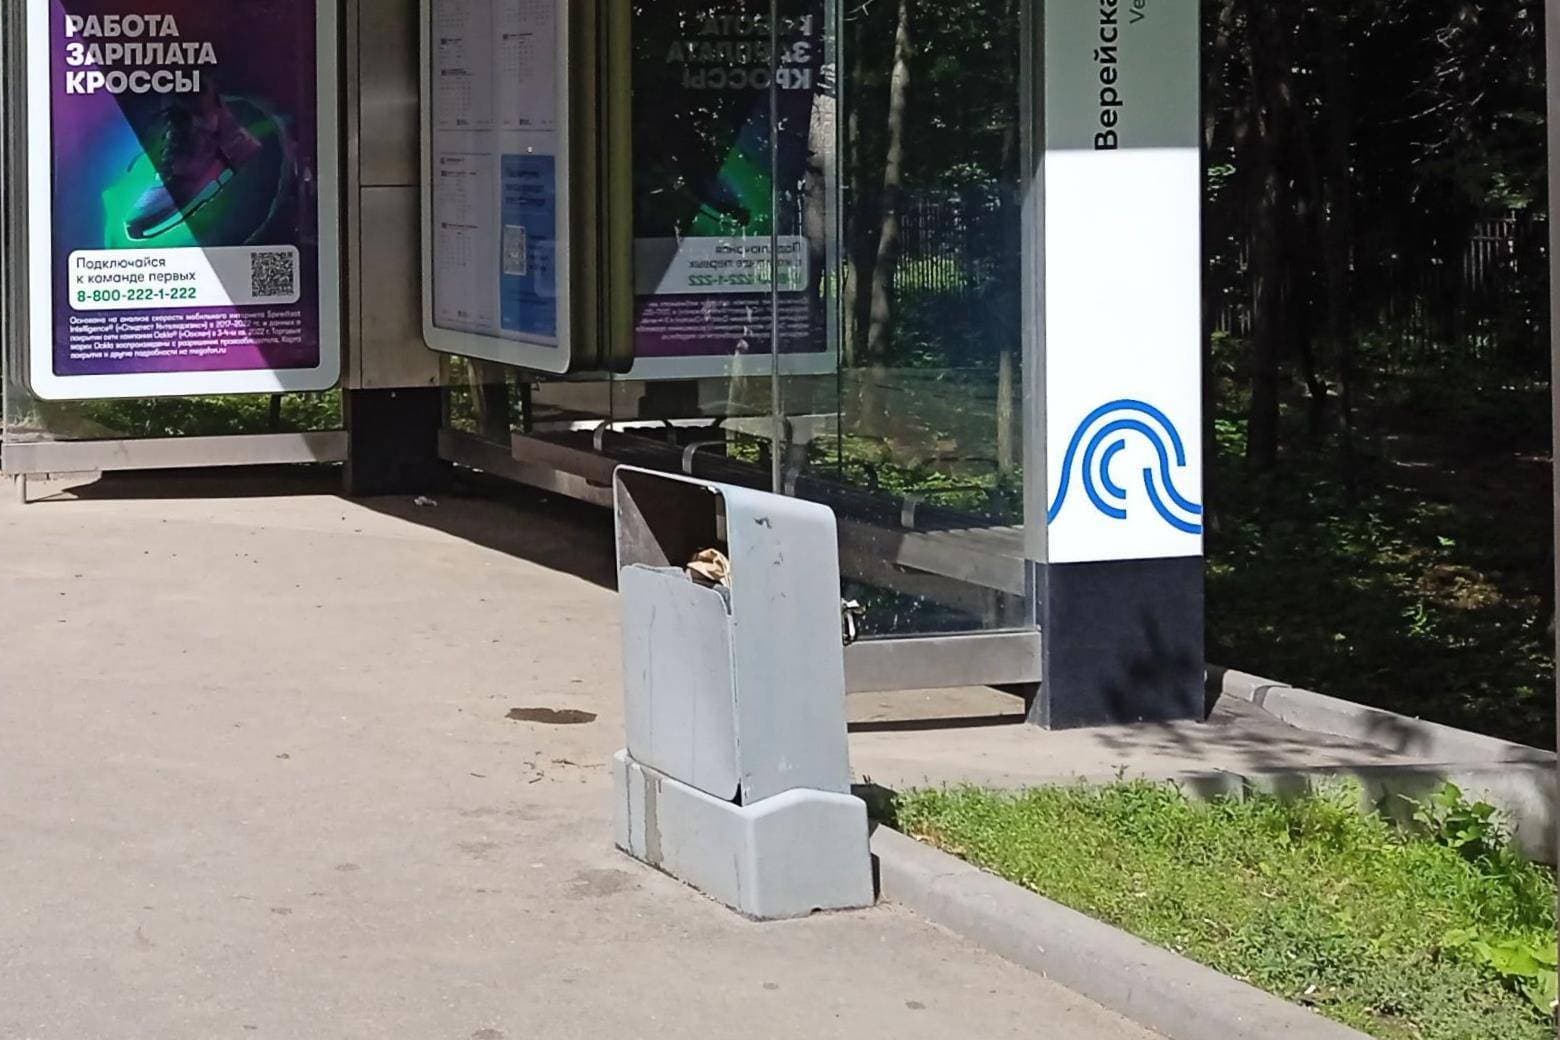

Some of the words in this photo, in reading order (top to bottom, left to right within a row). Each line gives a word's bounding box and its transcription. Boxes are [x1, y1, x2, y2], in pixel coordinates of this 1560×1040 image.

[65, 14, 180, 38] РАБОТА
[65, 41, 218, 67] ЗАРПЛАТА
[65, 70, 200, 95] КРОССЫ
[76, 256, 166, 270] Подключайся
[76, 275, 84, 284] к
[88, 273, 145, 284] команде
[148, 272, 196, 284] первых
[77, 287, 197, 302] 8-800-222-1-222
